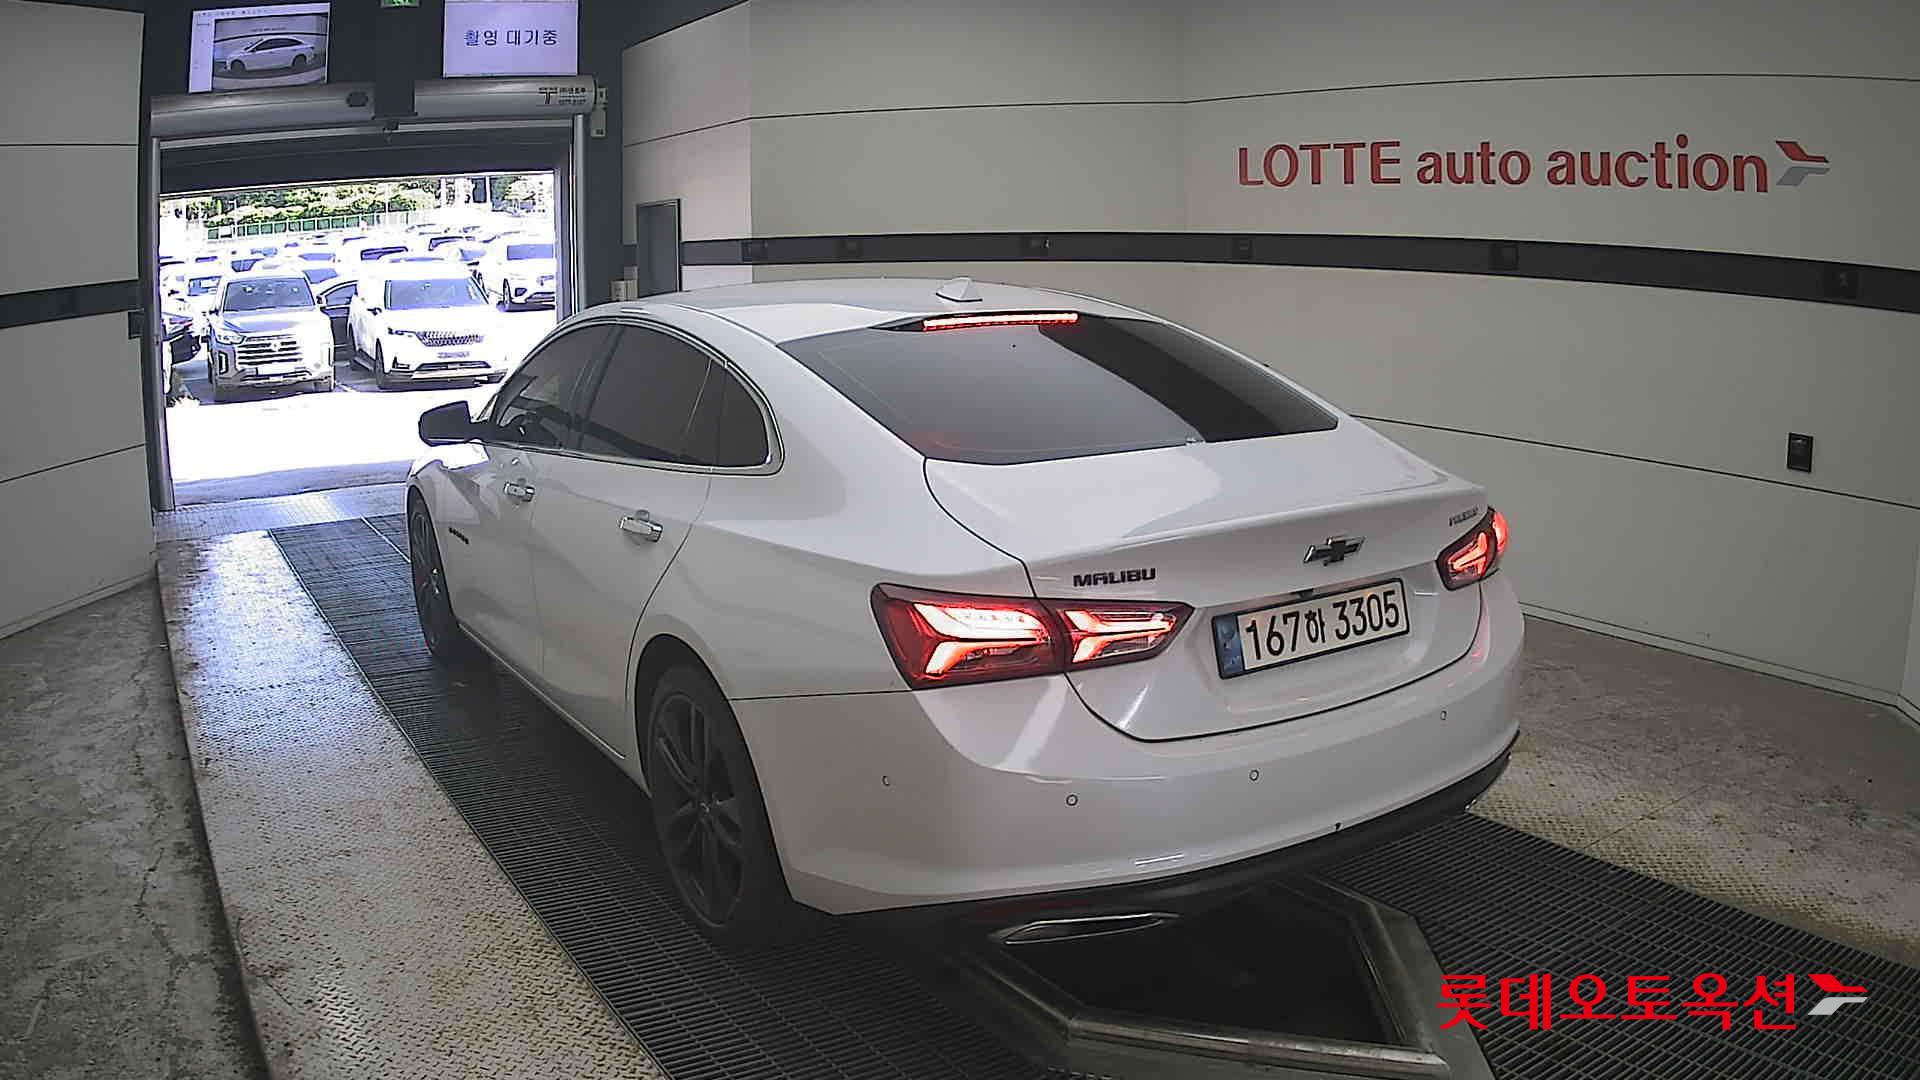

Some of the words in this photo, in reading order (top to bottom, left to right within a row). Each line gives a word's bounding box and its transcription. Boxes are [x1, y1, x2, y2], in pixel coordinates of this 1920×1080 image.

[506, 29, 558, 46] 대기중
[1238, 140, 1401, 187] LOTTE
[1416, 141, 1531, 186] auto
[1546, 134, 1768, 193] auction
[1073, 568, 1156, 588] MALIBU
[1245, 608, 1327, 660] 167하
[1333, 590, 1400, 640] 3305
